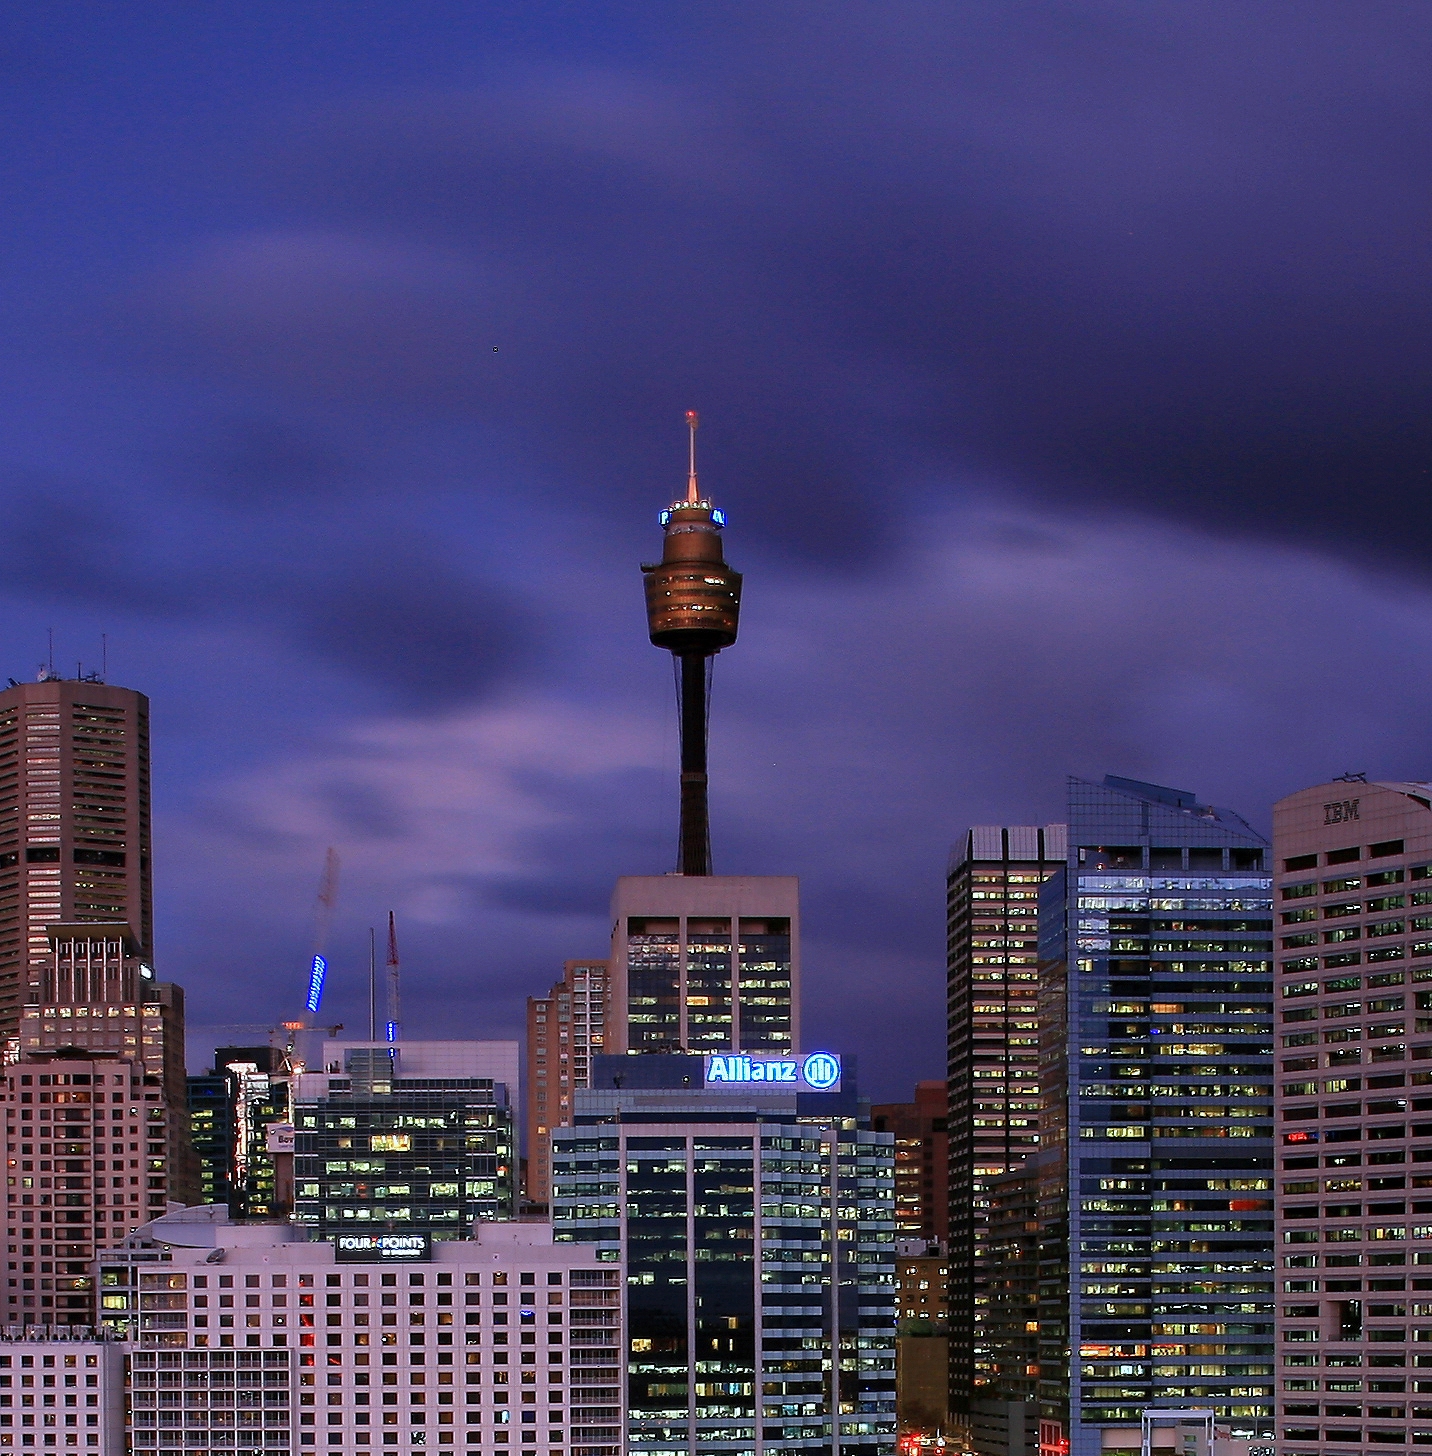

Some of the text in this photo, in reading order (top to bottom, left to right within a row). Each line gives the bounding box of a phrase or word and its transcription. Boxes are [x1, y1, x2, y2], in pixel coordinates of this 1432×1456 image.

[1323, 798, 1360, 825] IBM
[708, 1056, 797, 1081] Allianz
[339, 1236, 425, 1249] FOUR POINTS
